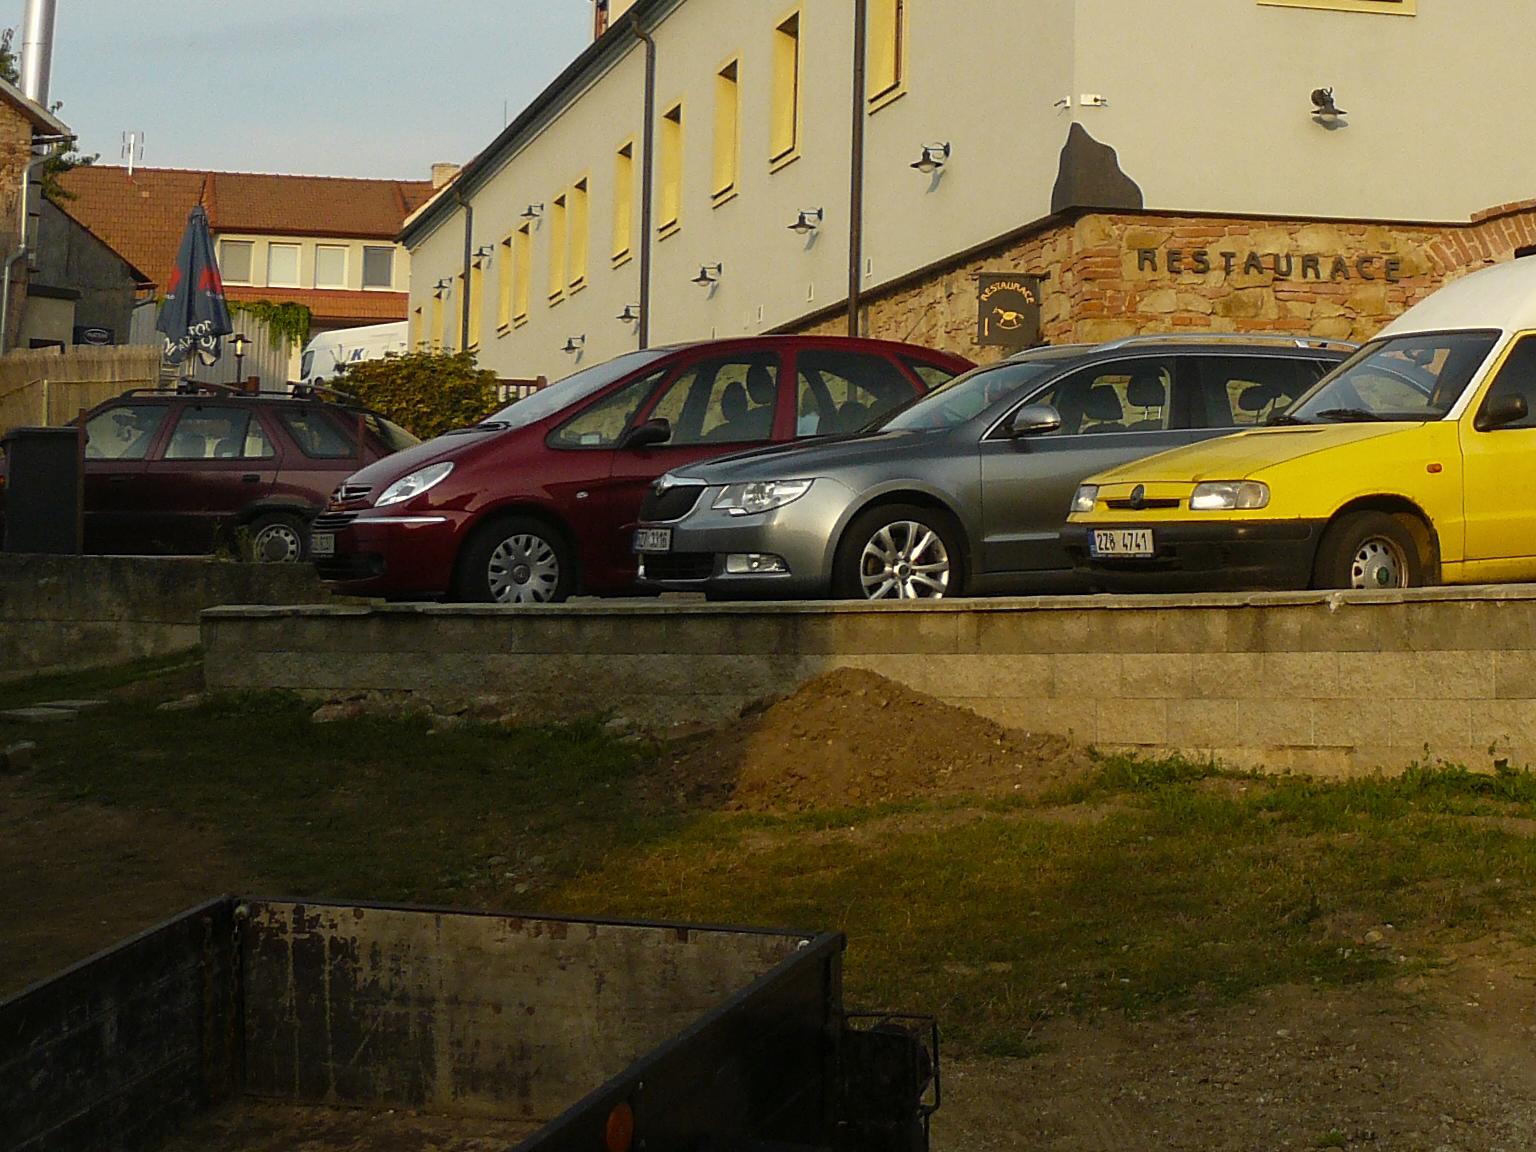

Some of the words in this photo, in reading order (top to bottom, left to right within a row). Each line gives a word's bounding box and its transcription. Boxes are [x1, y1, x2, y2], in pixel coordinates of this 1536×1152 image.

[1137, 248, 1401, 283] RESTAURACE
[981, 281, 1035, 304] RESTAURACE
[1122, 532, 1147, 551] 4741
